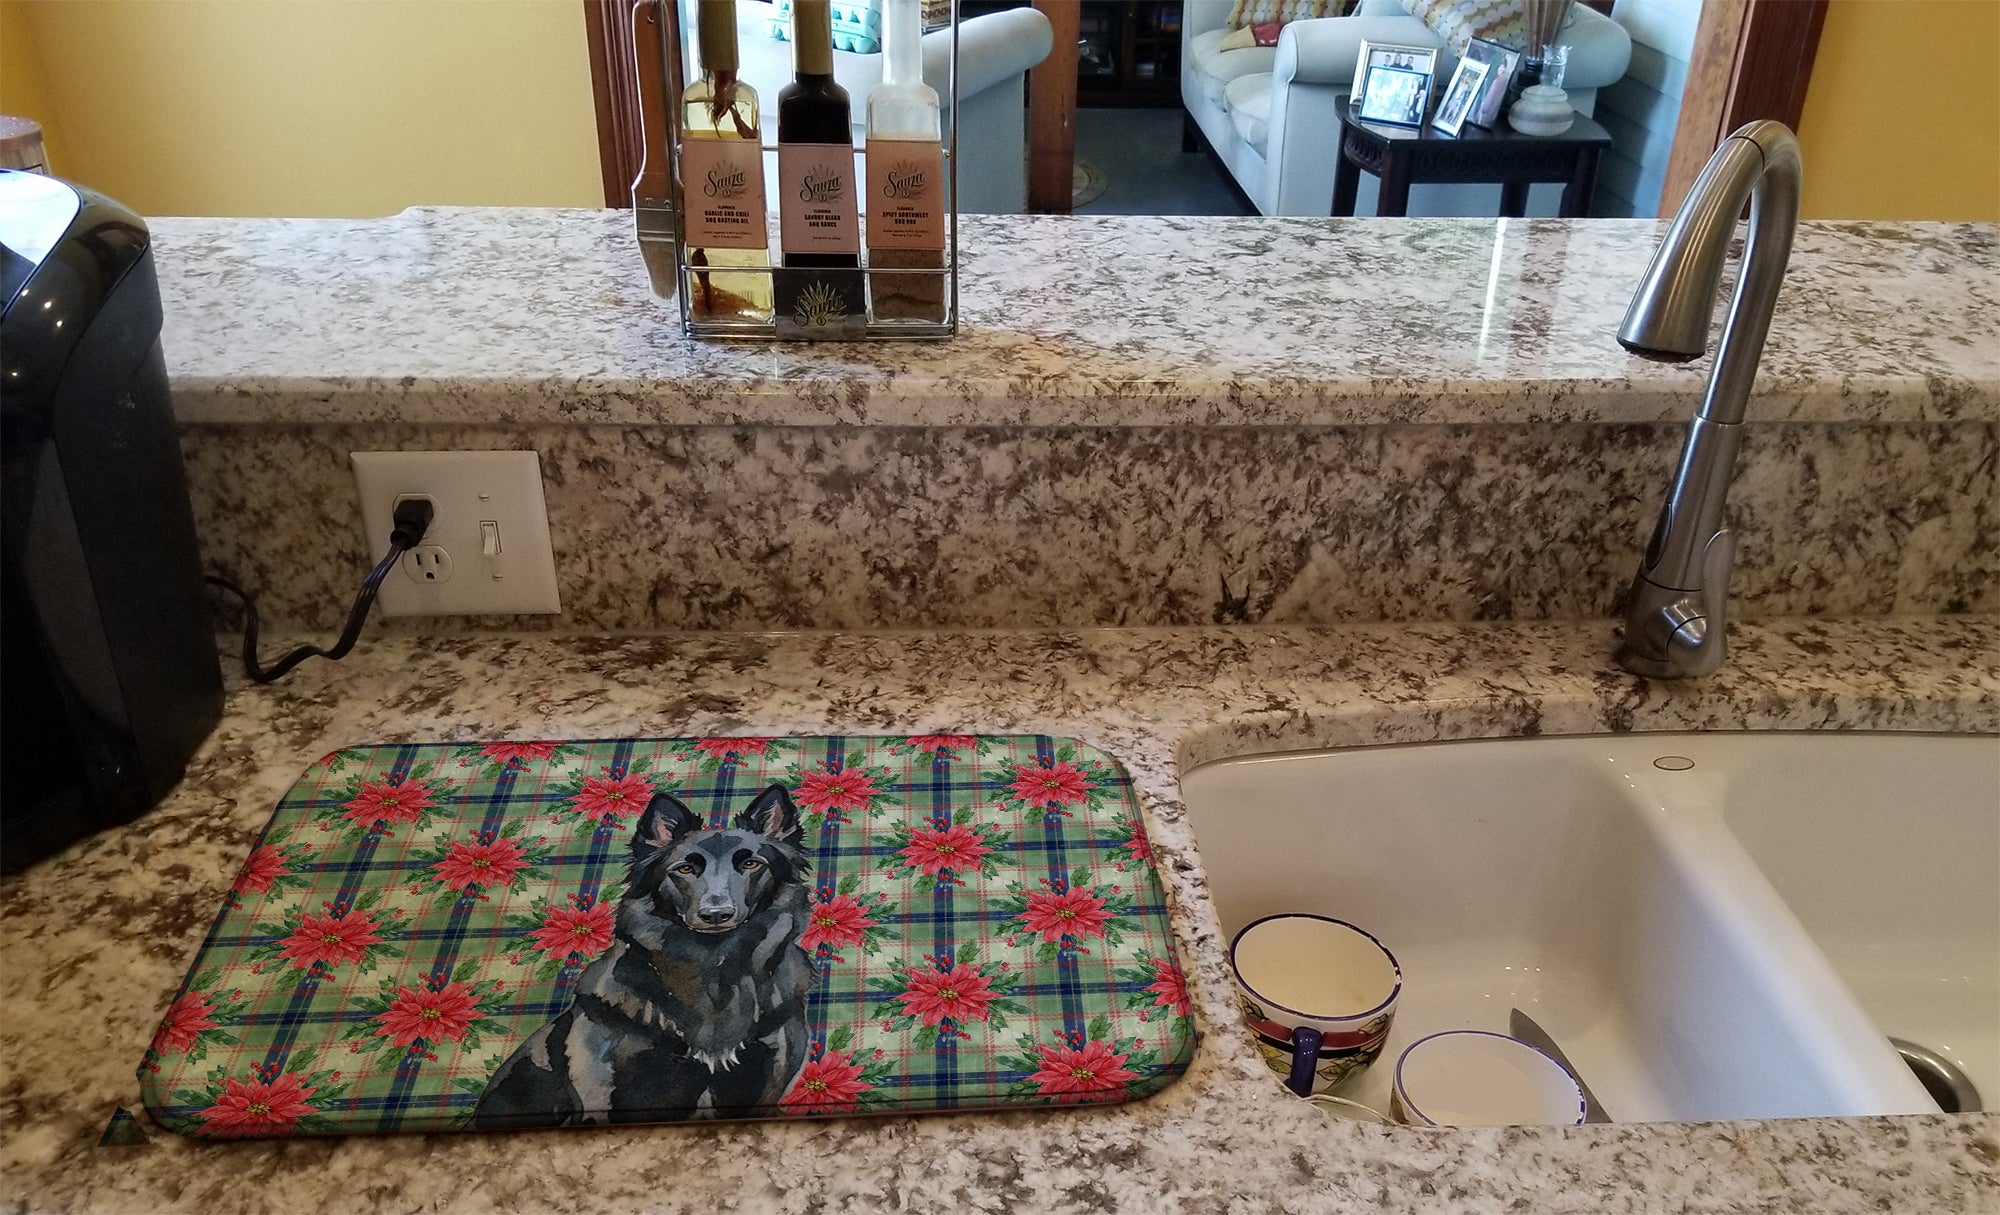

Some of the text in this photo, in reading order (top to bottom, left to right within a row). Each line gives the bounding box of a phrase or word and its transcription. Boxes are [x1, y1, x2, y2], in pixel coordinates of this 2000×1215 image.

[703, 170, 746, 197] Sauza
[800, 175, 842, 202] Sauza
[883, 170, 927, 198] Sauza
[792, 294, 844, 327] Sauza
